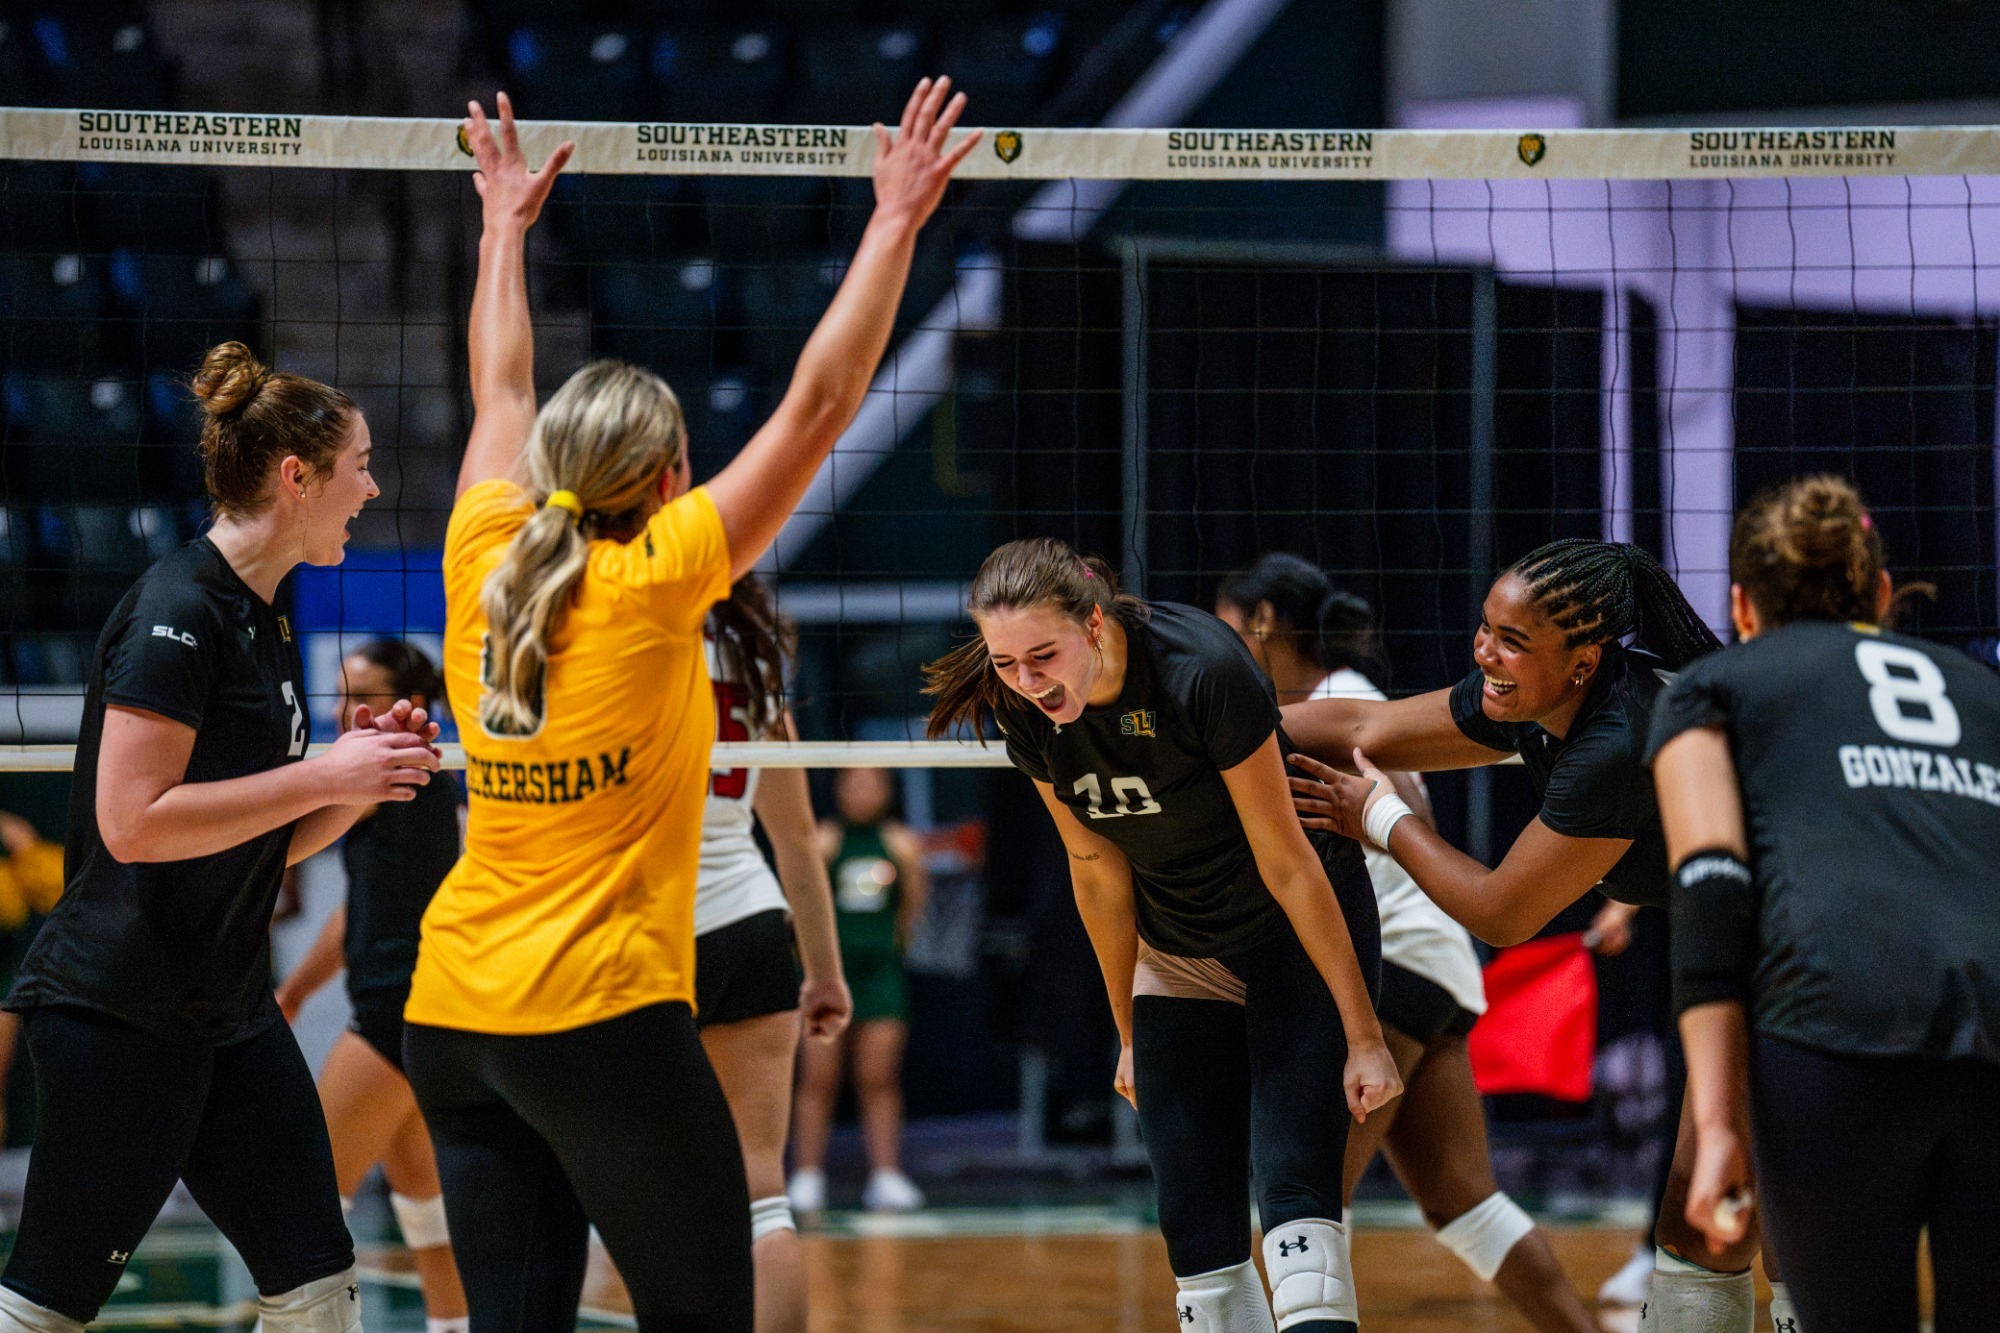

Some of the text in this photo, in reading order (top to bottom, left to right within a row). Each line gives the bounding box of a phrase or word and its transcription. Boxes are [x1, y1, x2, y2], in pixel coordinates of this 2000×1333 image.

[79, 112, 302, 138] SOUTHEASTERN
[637, 124, 848, 147] SOUTHEASTERN
[79, 137, 302, 155] LOUISIANA UNIVERSITY
[1168, 132, 1373, 151] SOUTHEASTERN
[1691, 130, 1896, 150] SOUTHEASTERN
[637, 149, 848, 165] LOUISIANA UNIVERSITY
[1168, 155, 1373, 168] LOUISIANA UNIVERSITY
[1690, 152, 1896, 168] LOUISIANA UNIVERSITY
[152, 624, 198, 649] SLC
[1854, 639, 1961, 748] 8
[281, 680, 306, 757] 2
[1838, 744, 2000, 808] GONZALE
[1073, 772, 1162, 819] 10
